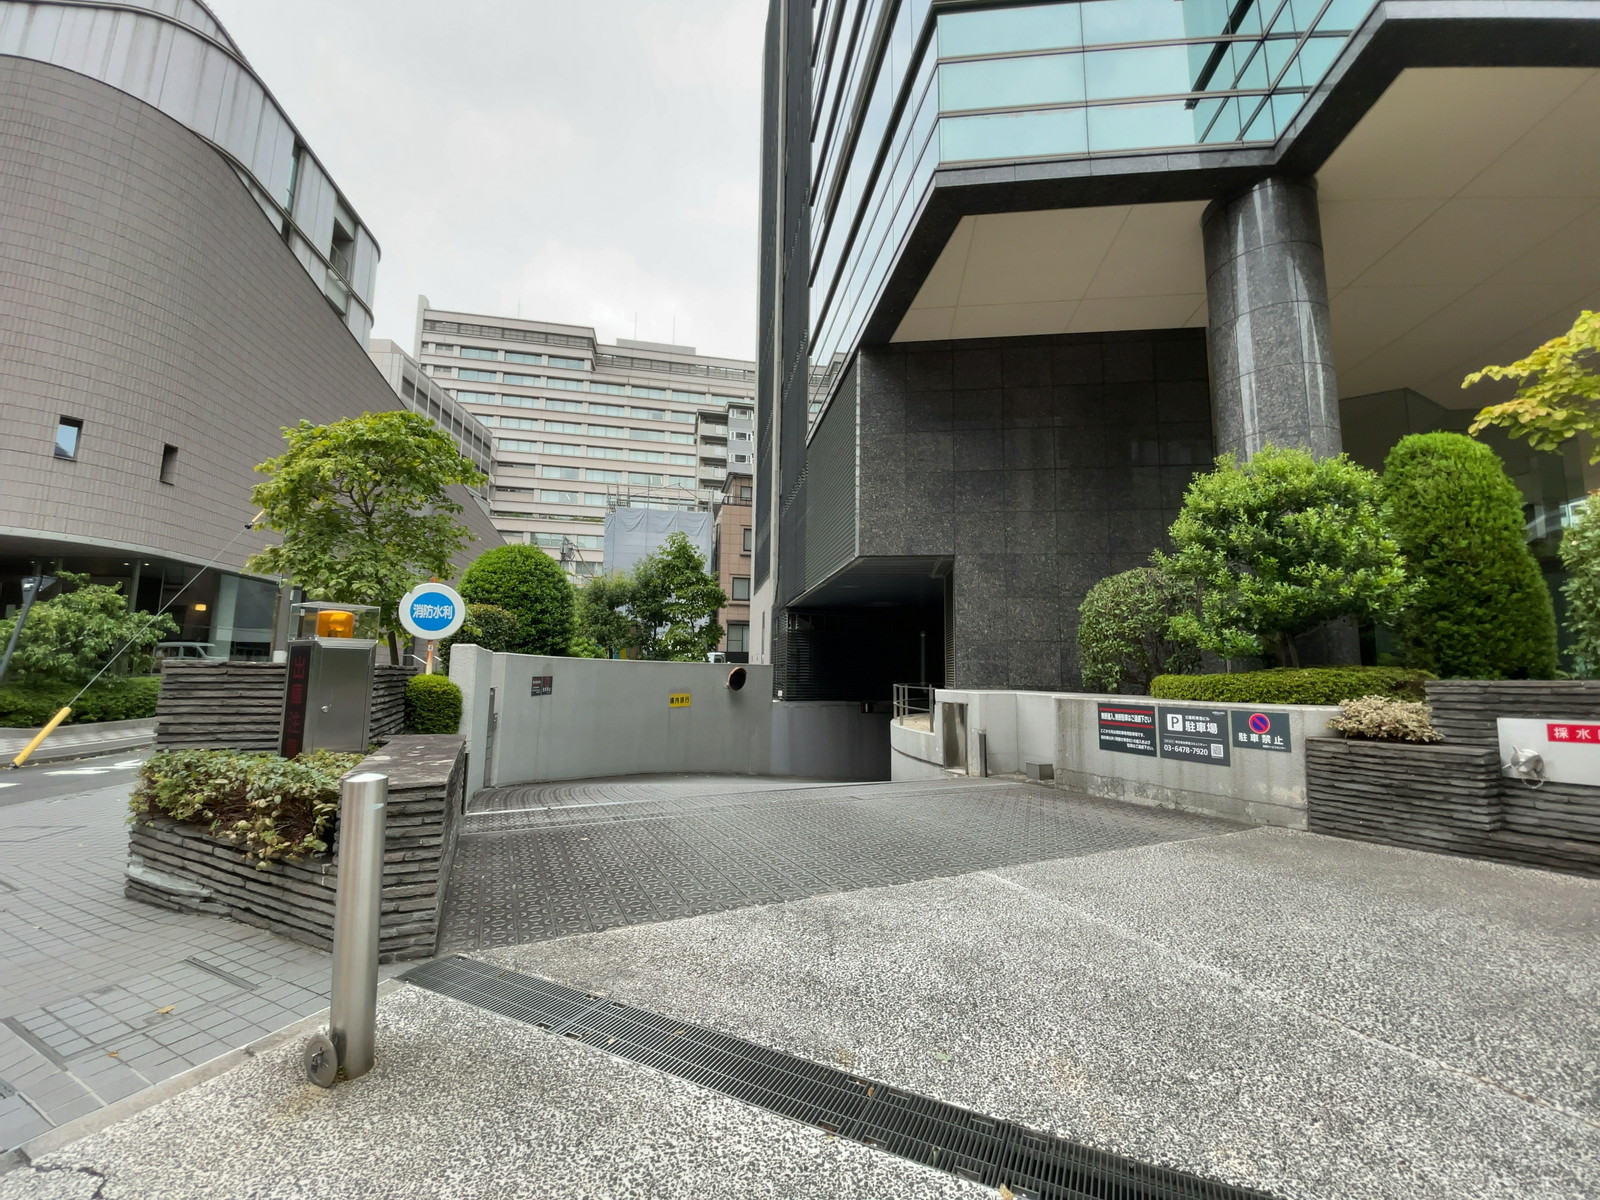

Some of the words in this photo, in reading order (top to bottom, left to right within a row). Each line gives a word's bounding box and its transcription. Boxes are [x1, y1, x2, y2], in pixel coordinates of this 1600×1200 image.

[413, 603, 453, 619] 消防水利
[1185, 720, 1218, 735] 駐車場
[1553, 727, 1600, 741] 採水
[1238, 732, 1284, 746] 駐車禁止
[1163, 744, 1209, 756] 03-6478-7920
